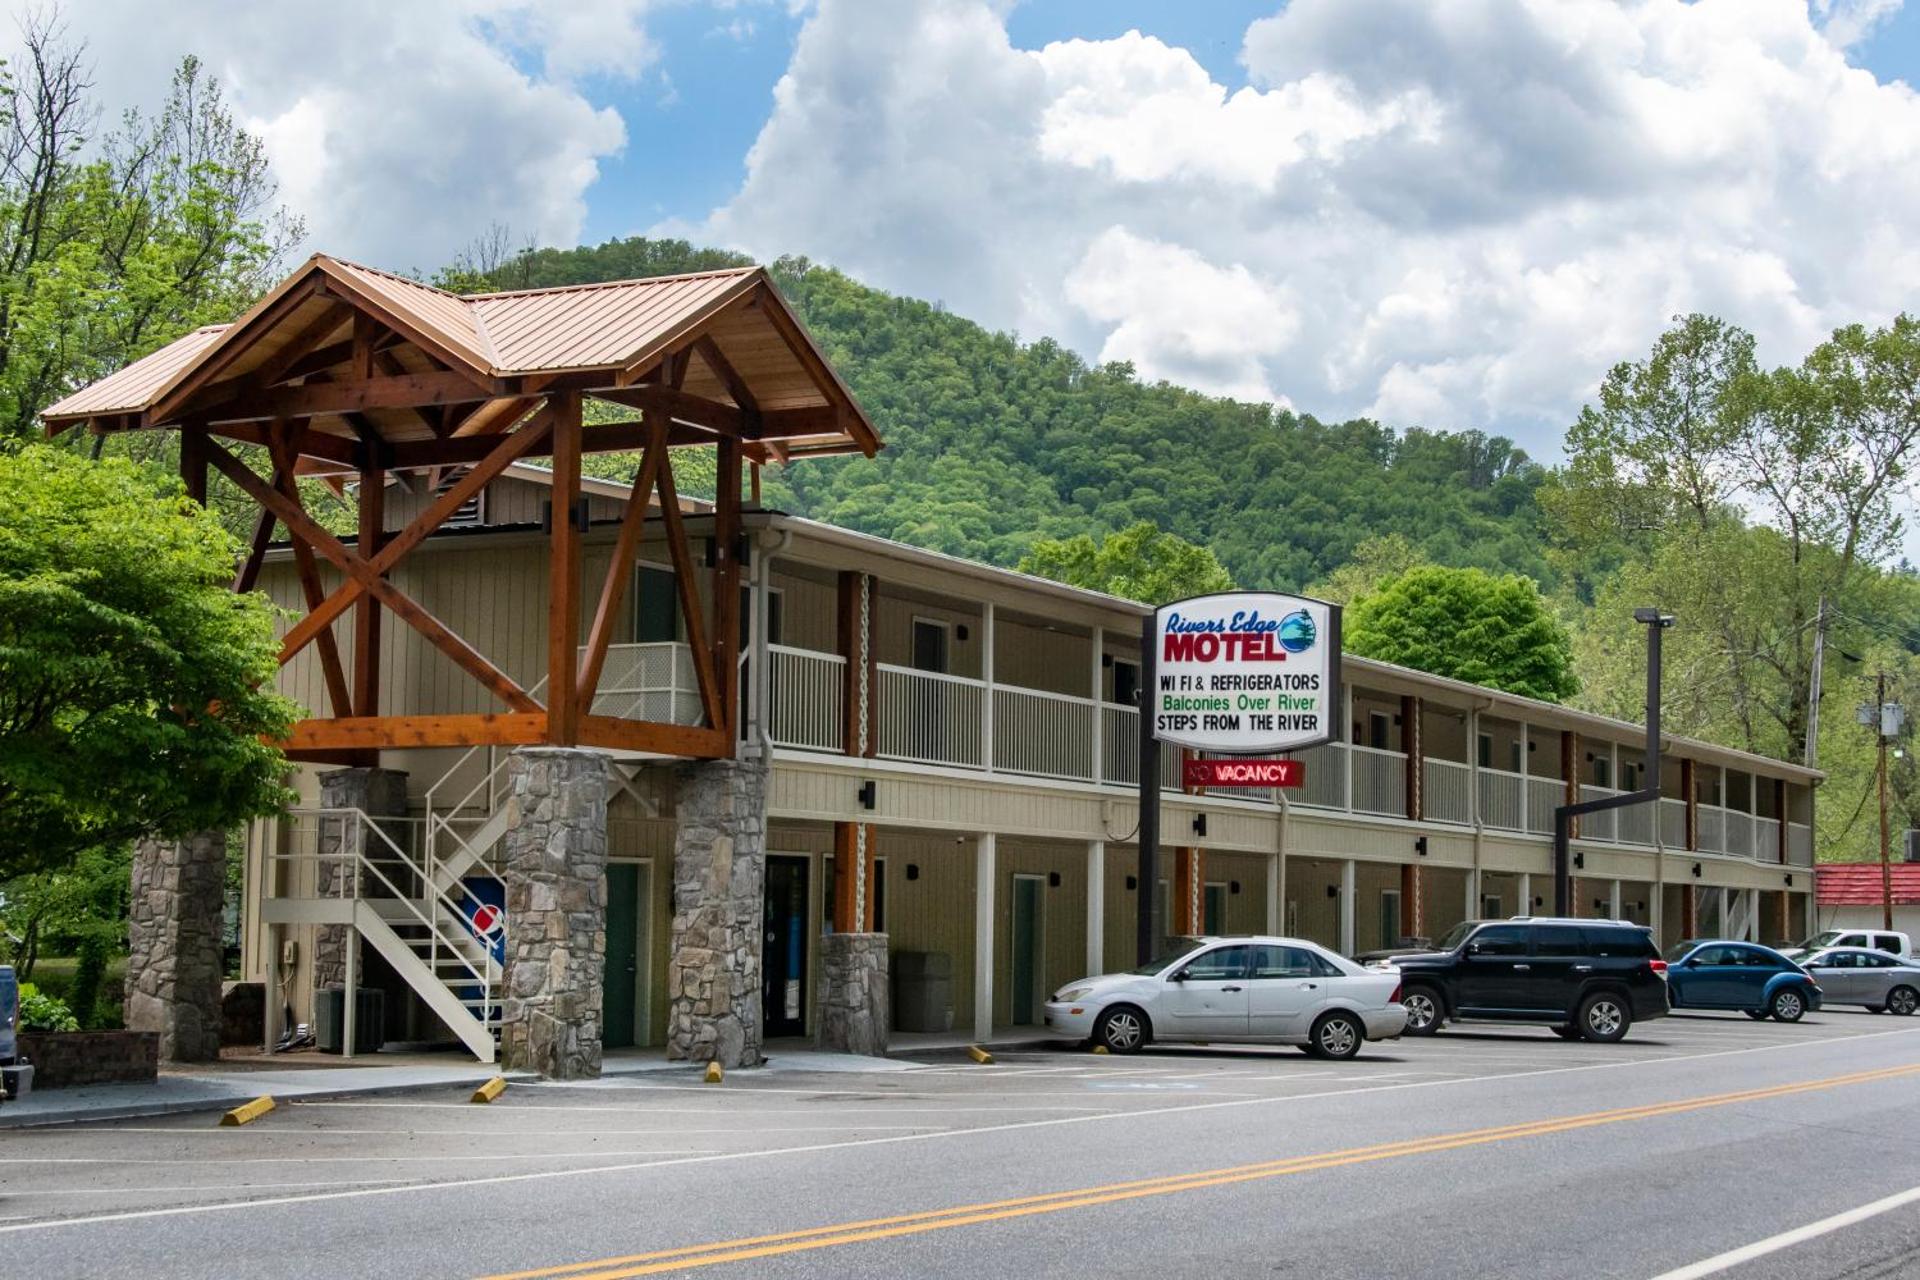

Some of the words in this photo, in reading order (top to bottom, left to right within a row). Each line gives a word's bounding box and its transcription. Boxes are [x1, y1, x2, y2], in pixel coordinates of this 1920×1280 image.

[1165, 612, 1225, 633] Rivers
[1229, 610, 1279, 639] Edge
[1164, 632, 1286, 662] MOTEL
[1195, 676, 1204, 691] &
[1211, 674, 1320, 691] REFRIGERATORS
[1163, 695, 1230, 711] Balconies
[1237, 695, 1270, 711] Over
[1278, 694, 1315, 710] River
[1157, 715, 1197, 730] STEPS
[1203, 715, 1240, 730] FROM
[1249, 715, 1273, 730] THE
[1278, 715, 1318, 730] RIVER
[1215, 764, 1288, 782] VACANCY
